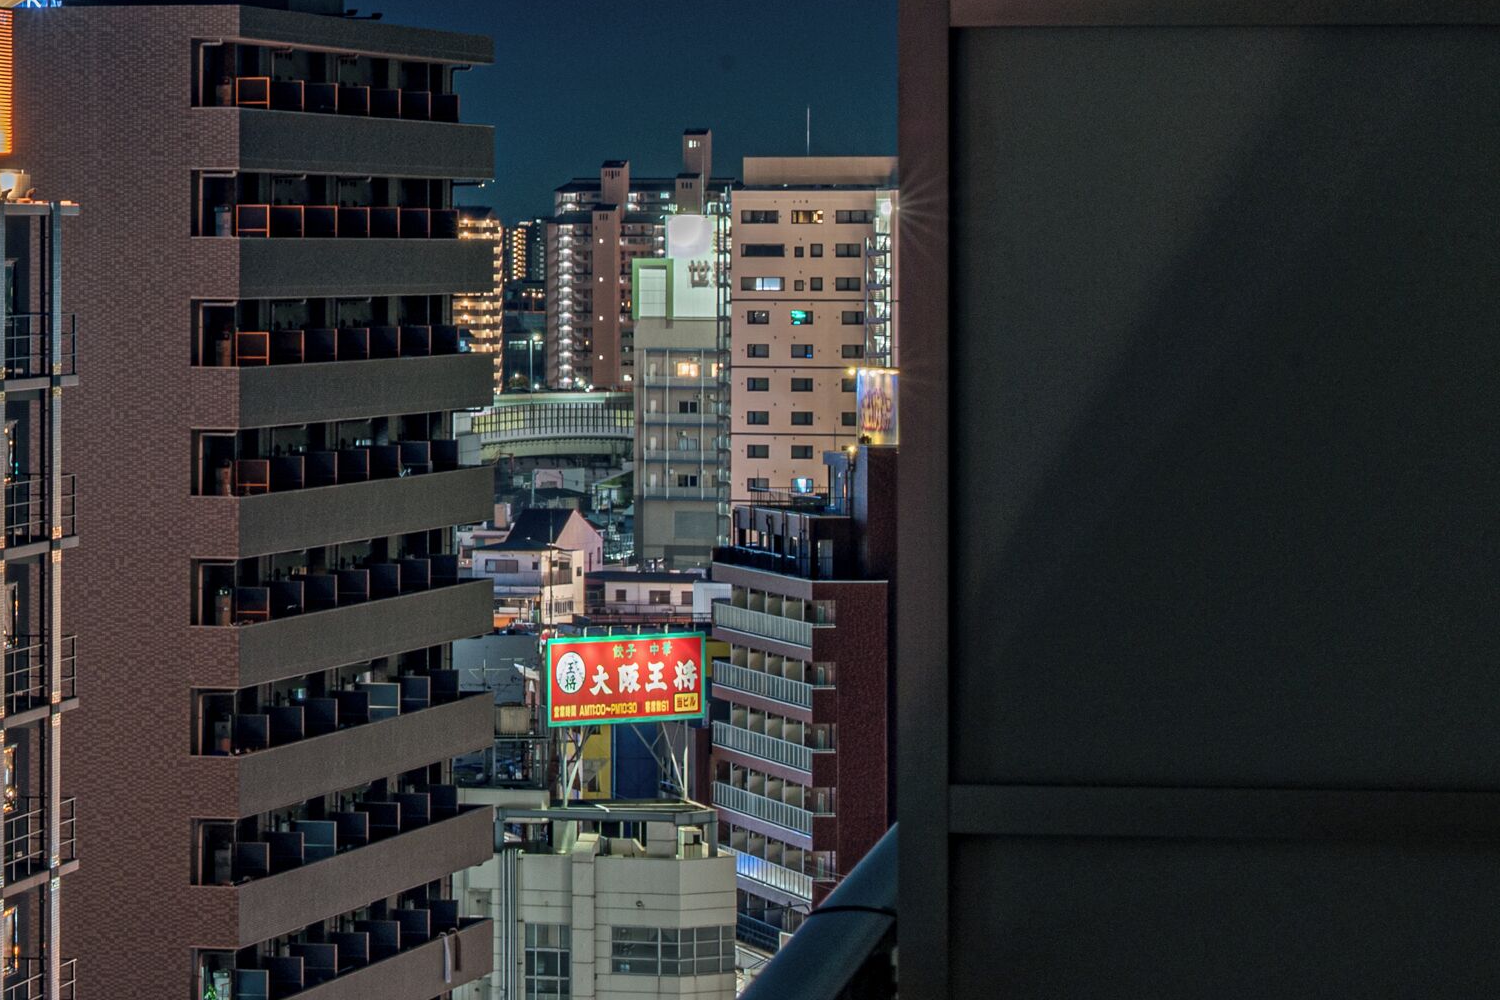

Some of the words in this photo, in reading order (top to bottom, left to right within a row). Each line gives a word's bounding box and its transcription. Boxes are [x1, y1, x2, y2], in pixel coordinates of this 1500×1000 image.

[612, 643, 637, 659] 餃子
[650, 641, 673, 656] 中華
[564, 662, 578, 691] 王将
[589, 659, 698, 696] 大阪王将
